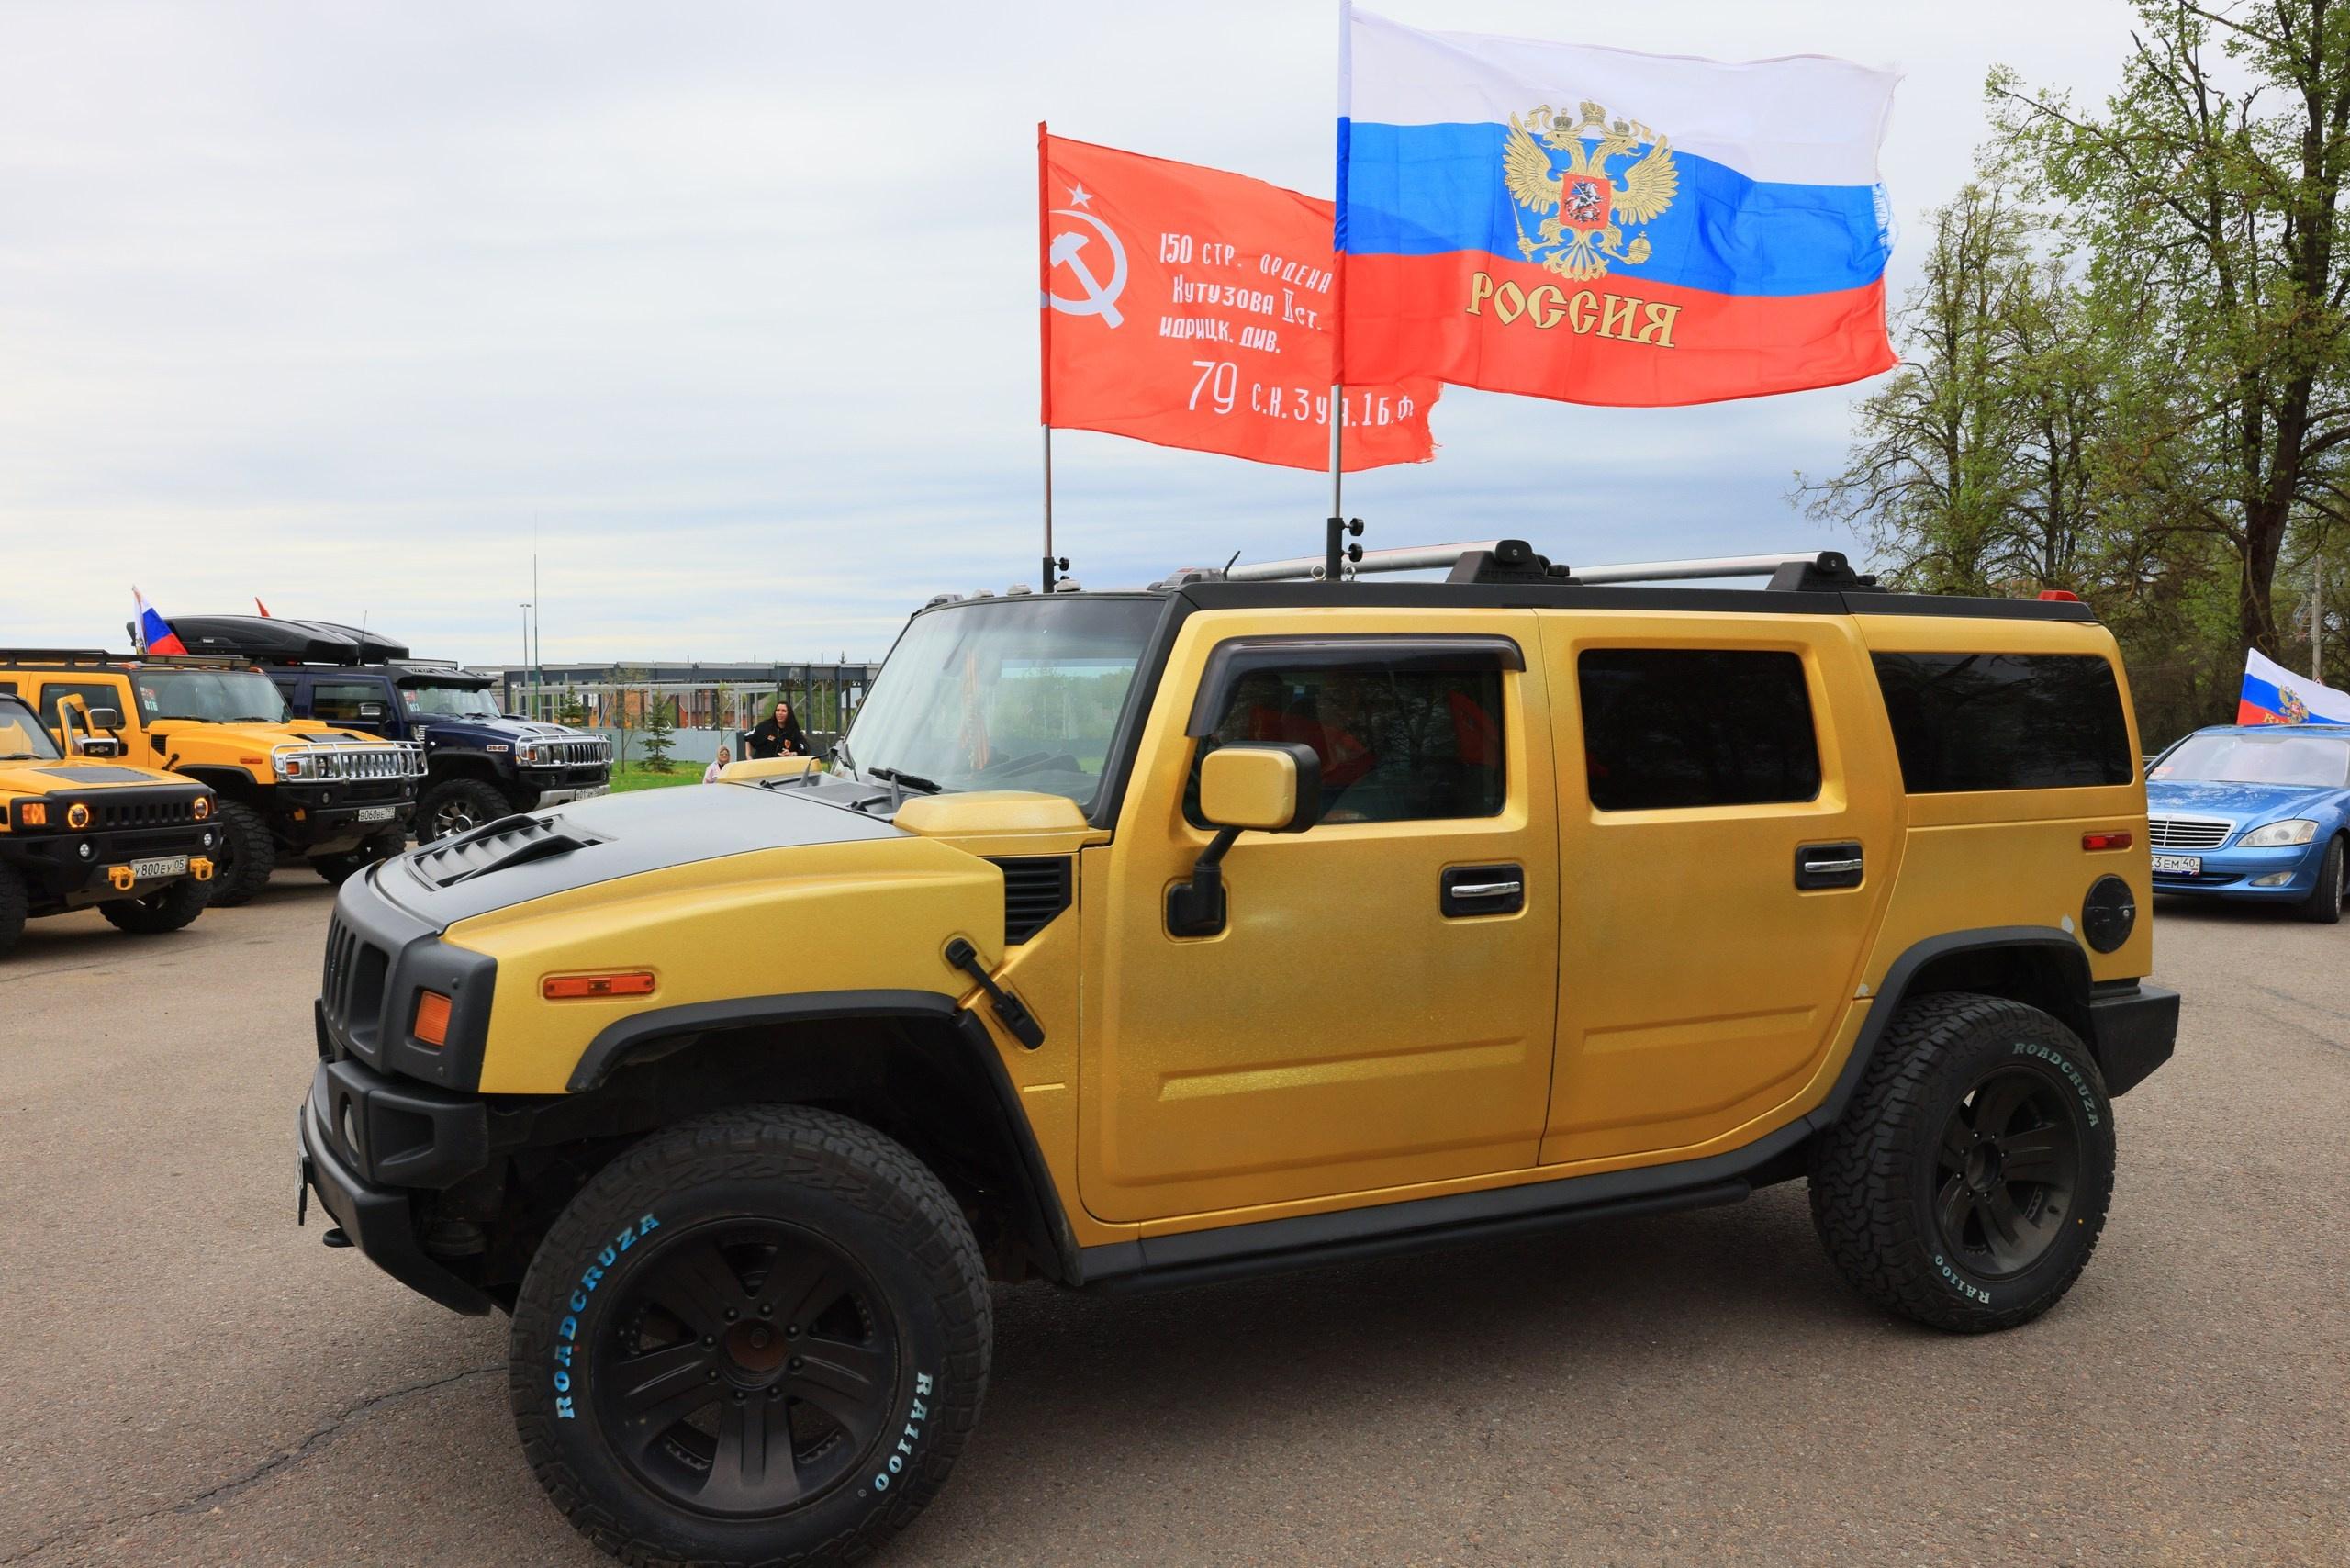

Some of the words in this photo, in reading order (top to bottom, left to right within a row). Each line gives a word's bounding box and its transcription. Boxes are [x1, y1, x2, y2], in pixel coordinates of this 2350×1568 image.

[1159, 232, 1192, 264] 150
[1203, 242, 1242, 267] СТР.
[1259, 253, 1333, 294] ОРДЕНА
[1159, 316, 1234, 343] ИДРИЦК.
[1238, 326, 1281, 353] ДИВ.
[1466, 272, 1683, 349] РОССИЯ
[1189, 360, 1238, 415] 79
[2013, 1042, 2100, 1128] ROADCRUZA
[1934, 1254, 1991, 1305] RA1100
[554, 1213, 661, 1420] ROADCRUZA
[874, 1372, 934, 1492] RA1100
